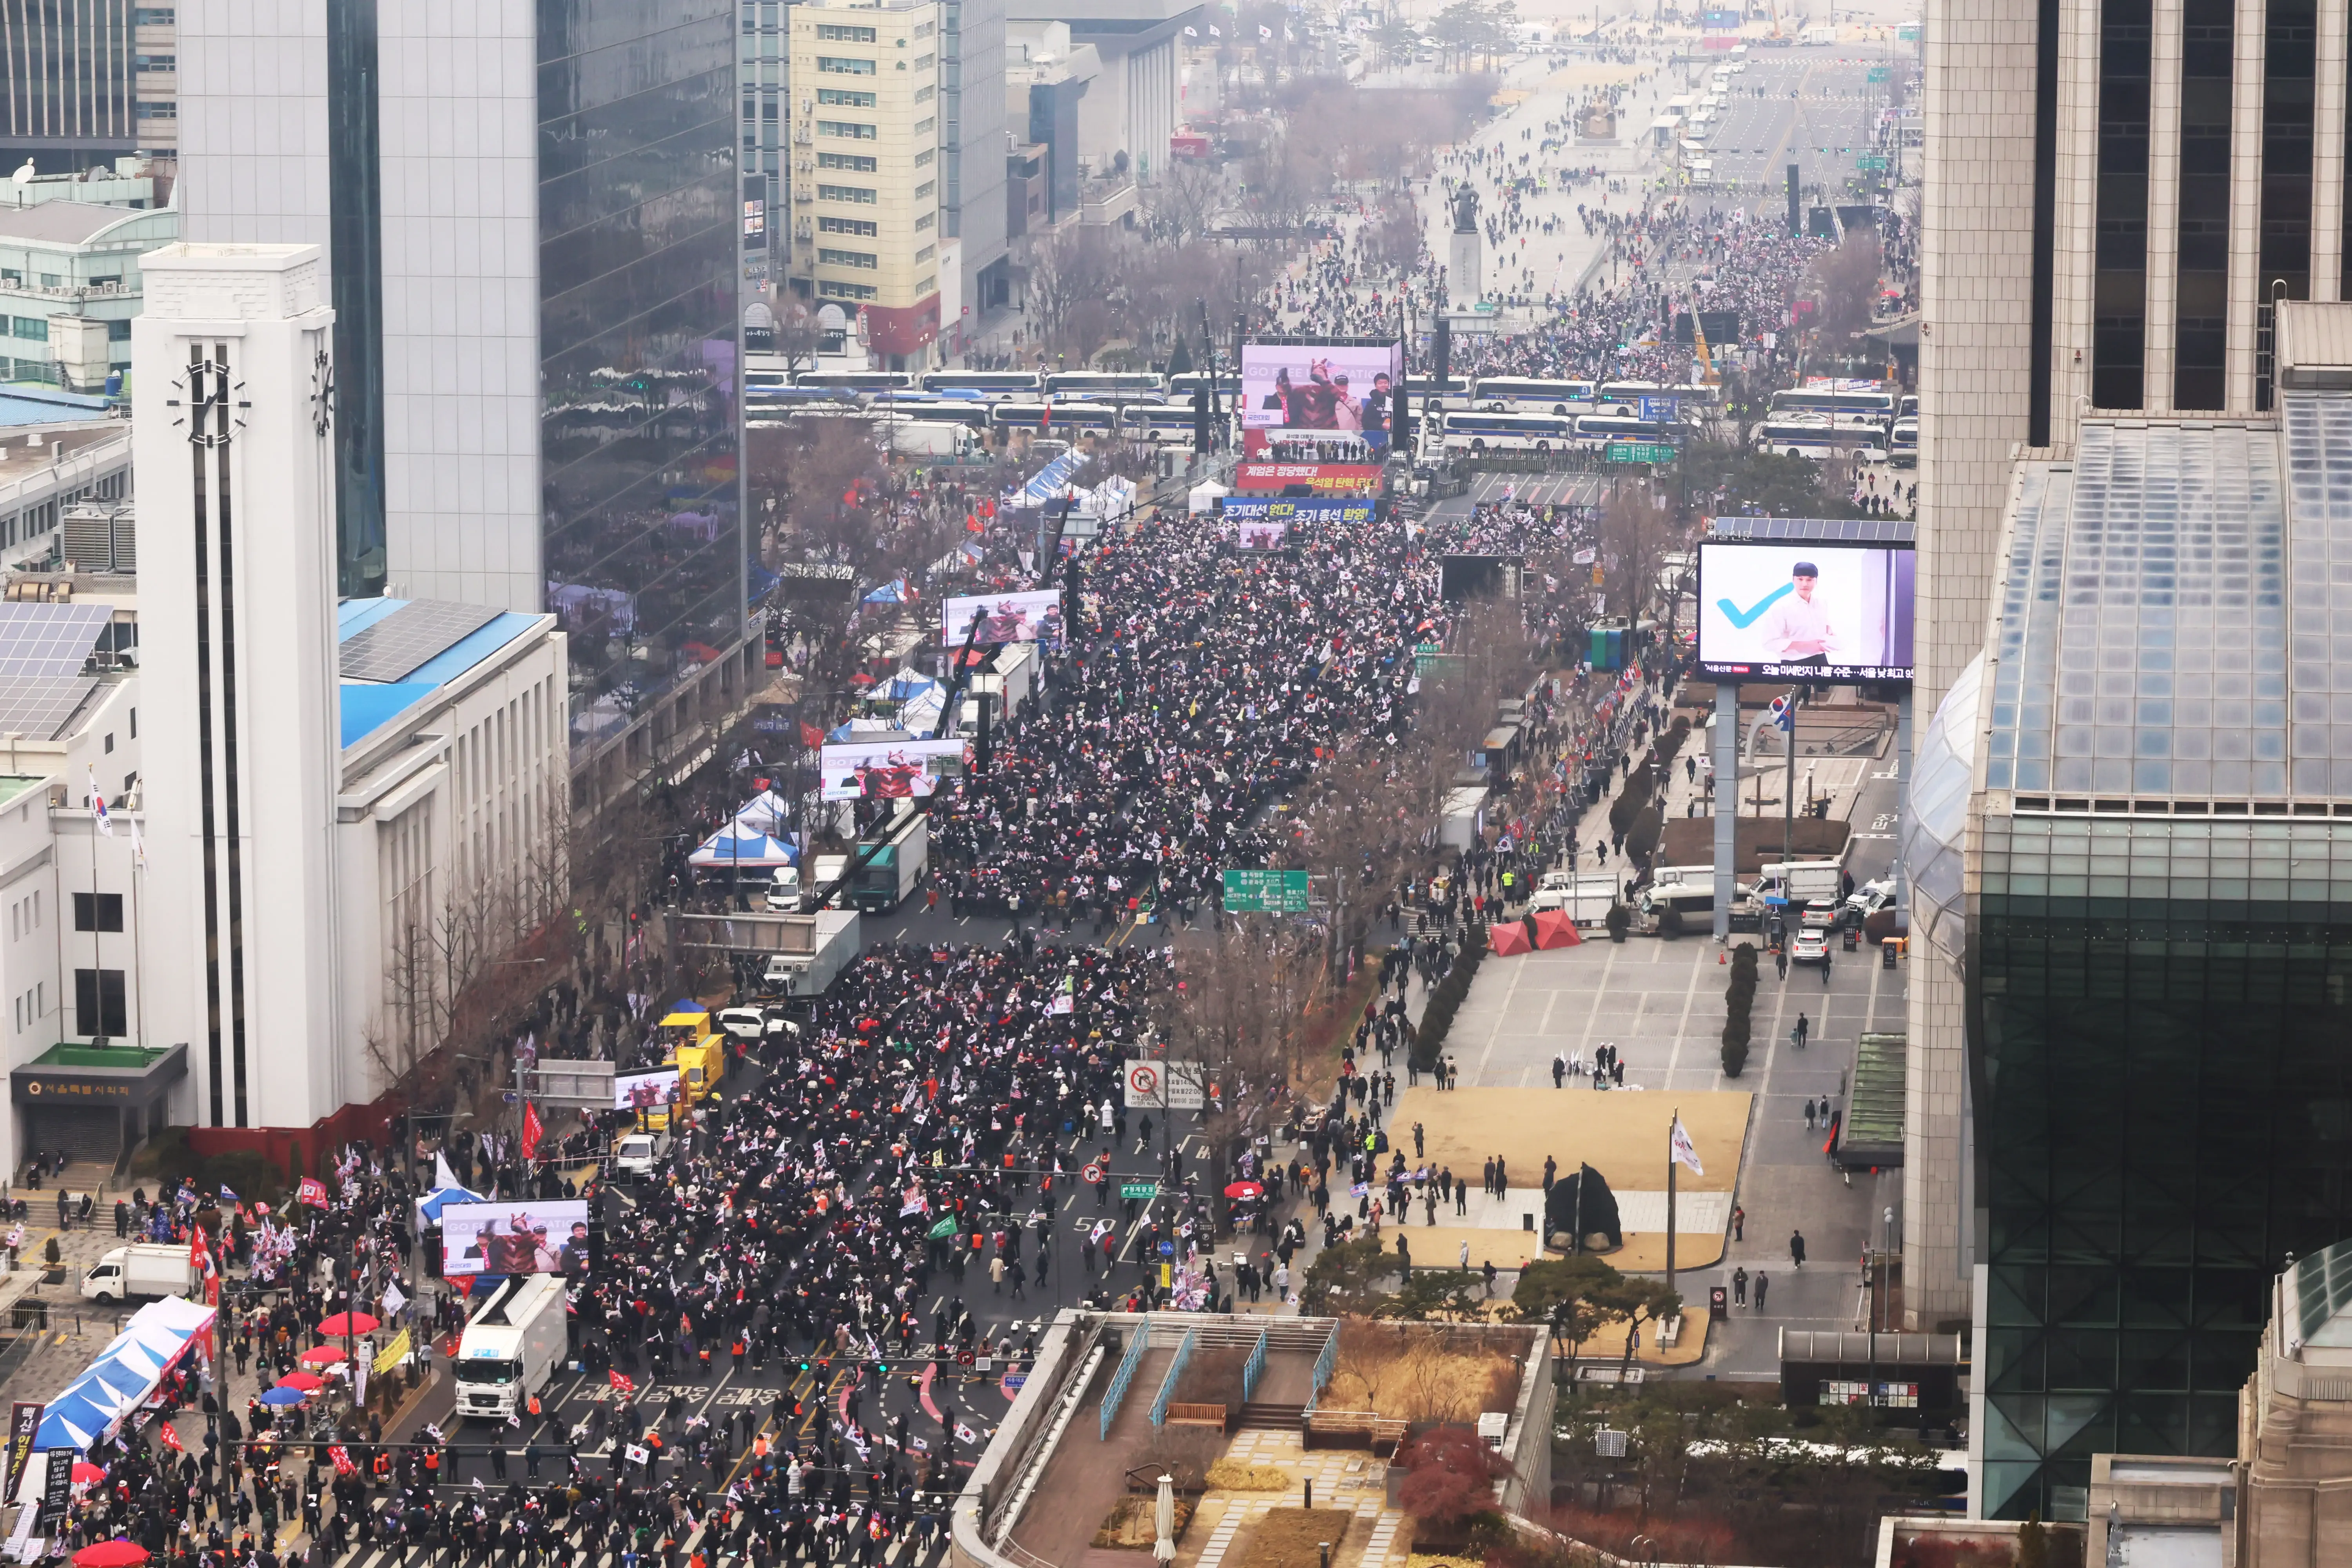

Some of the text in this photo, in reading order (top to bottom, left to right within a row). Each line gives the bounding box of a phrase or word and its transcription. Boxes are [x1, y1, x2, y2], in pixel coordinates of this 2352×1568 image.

[1248, 367, 1268, 376] GO
[1272, 367, 1303, 377] FEE
[1246, 466, 1318, 477] 계엄은 정당했다!
[1335, 478, 1355, 488] 탄핵
[1225, 504, 1295, 517] 조기대선 없다!
[1294, 508, 1369, 522] 조기 총선 환영!
[1780, 665, 1813, 677] 미세먼지
[1877, 667, 1887, 679] 낮
[1887, 668, 1904, 679] 최고
[827, 759, 846, 767] GO
[45, 1083, 128, 1096] 서울특별시의회
[449, 1223, 468, 1231] GO
[716, 1387, 781, 1406] 숭례문
[20, 1406, 36, 1432] 백신
